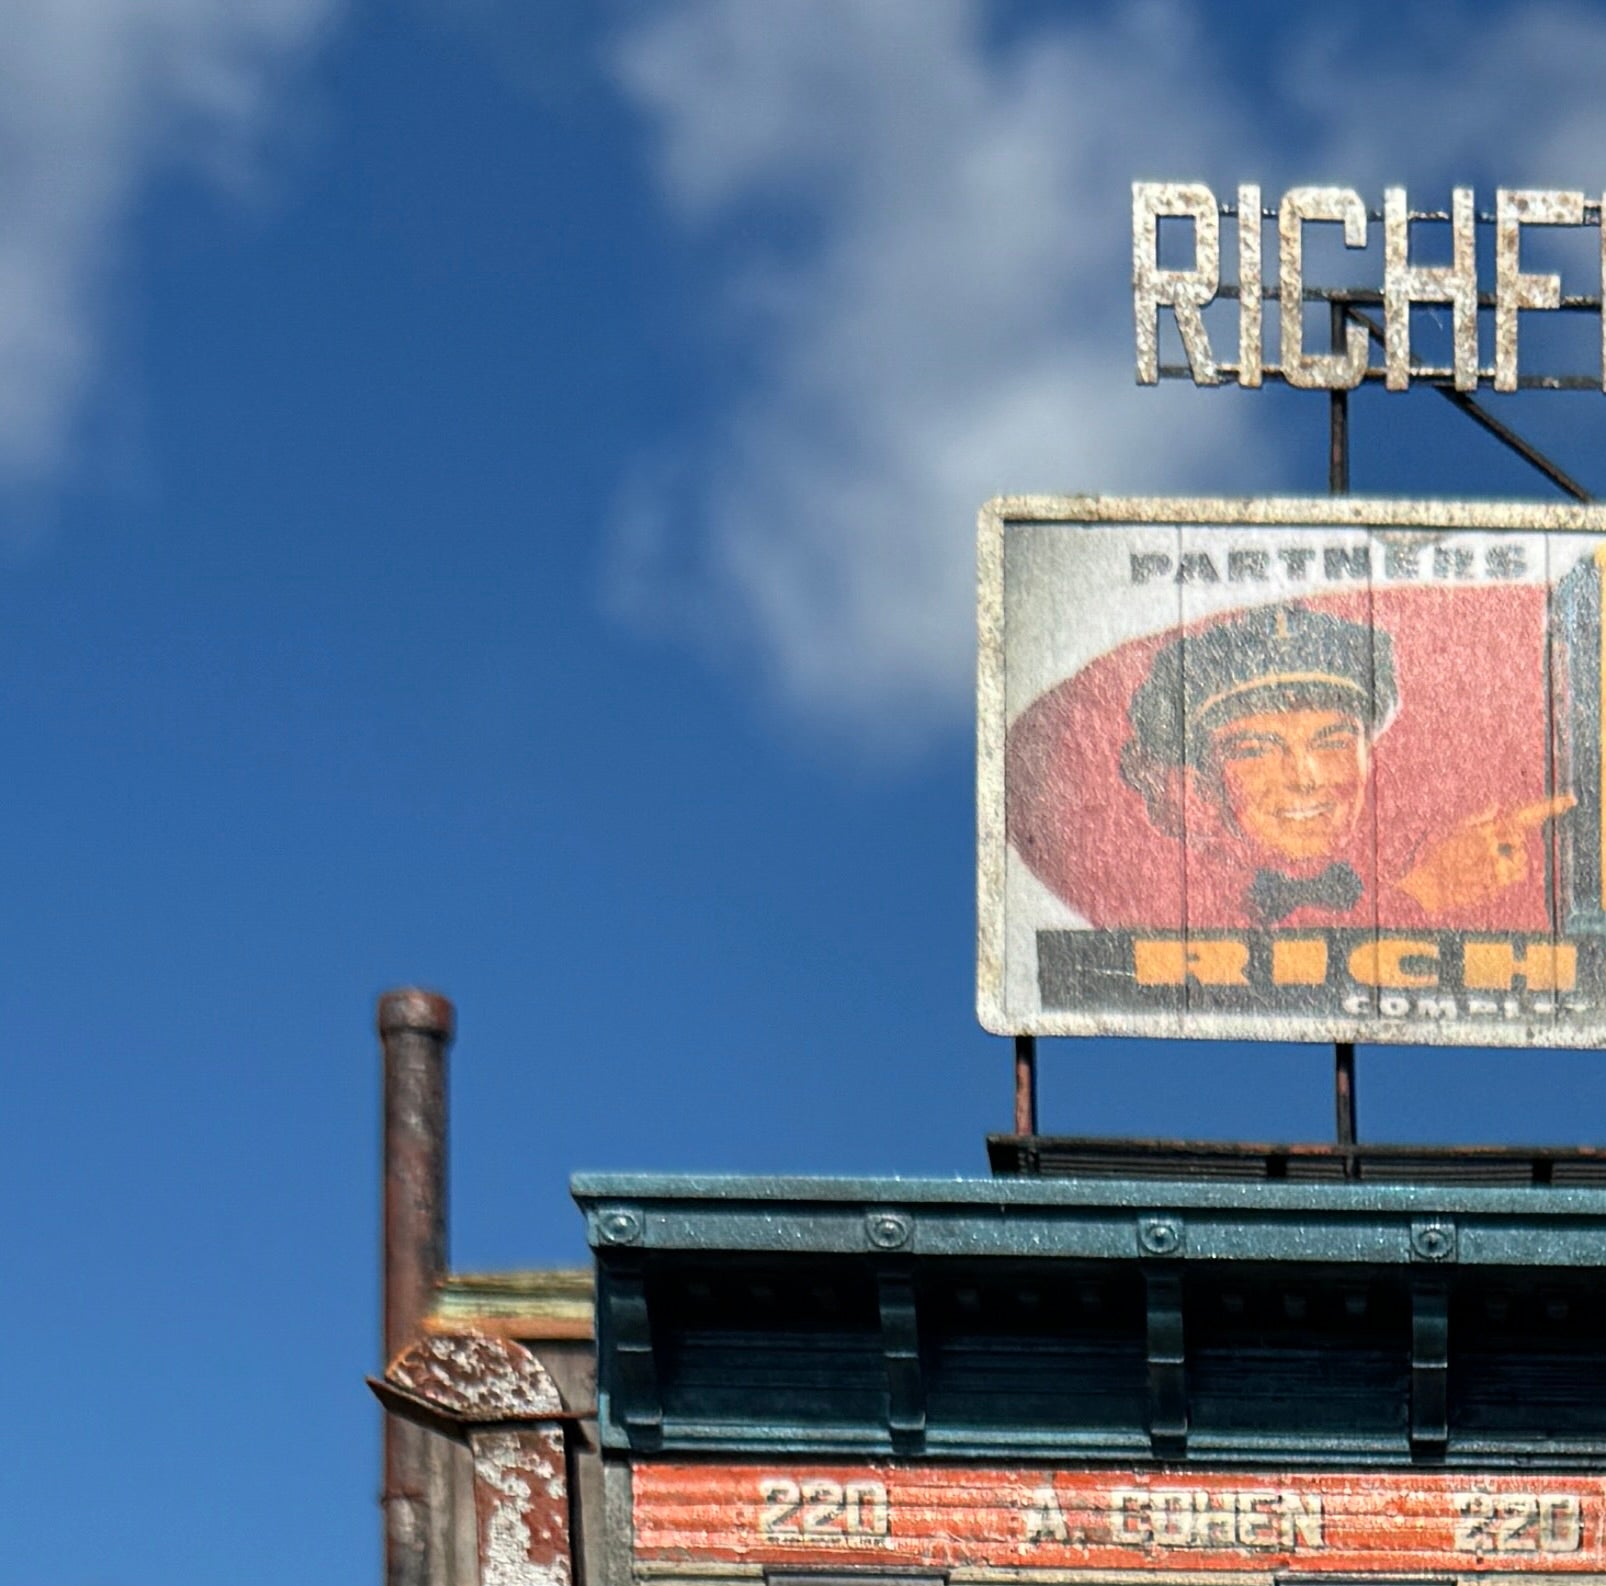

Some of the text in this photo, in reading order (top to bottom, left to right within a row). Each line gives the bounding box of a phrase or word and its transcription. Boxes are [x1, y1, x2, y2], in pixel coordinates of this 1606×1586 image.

[1129, 543, 1529, 586] PARTNERS
[757, 1477, 889, 1545] 220
[1109, 1488, 1325, 1551] COHEN
[1453, 1491, 1582, 1552] 220
